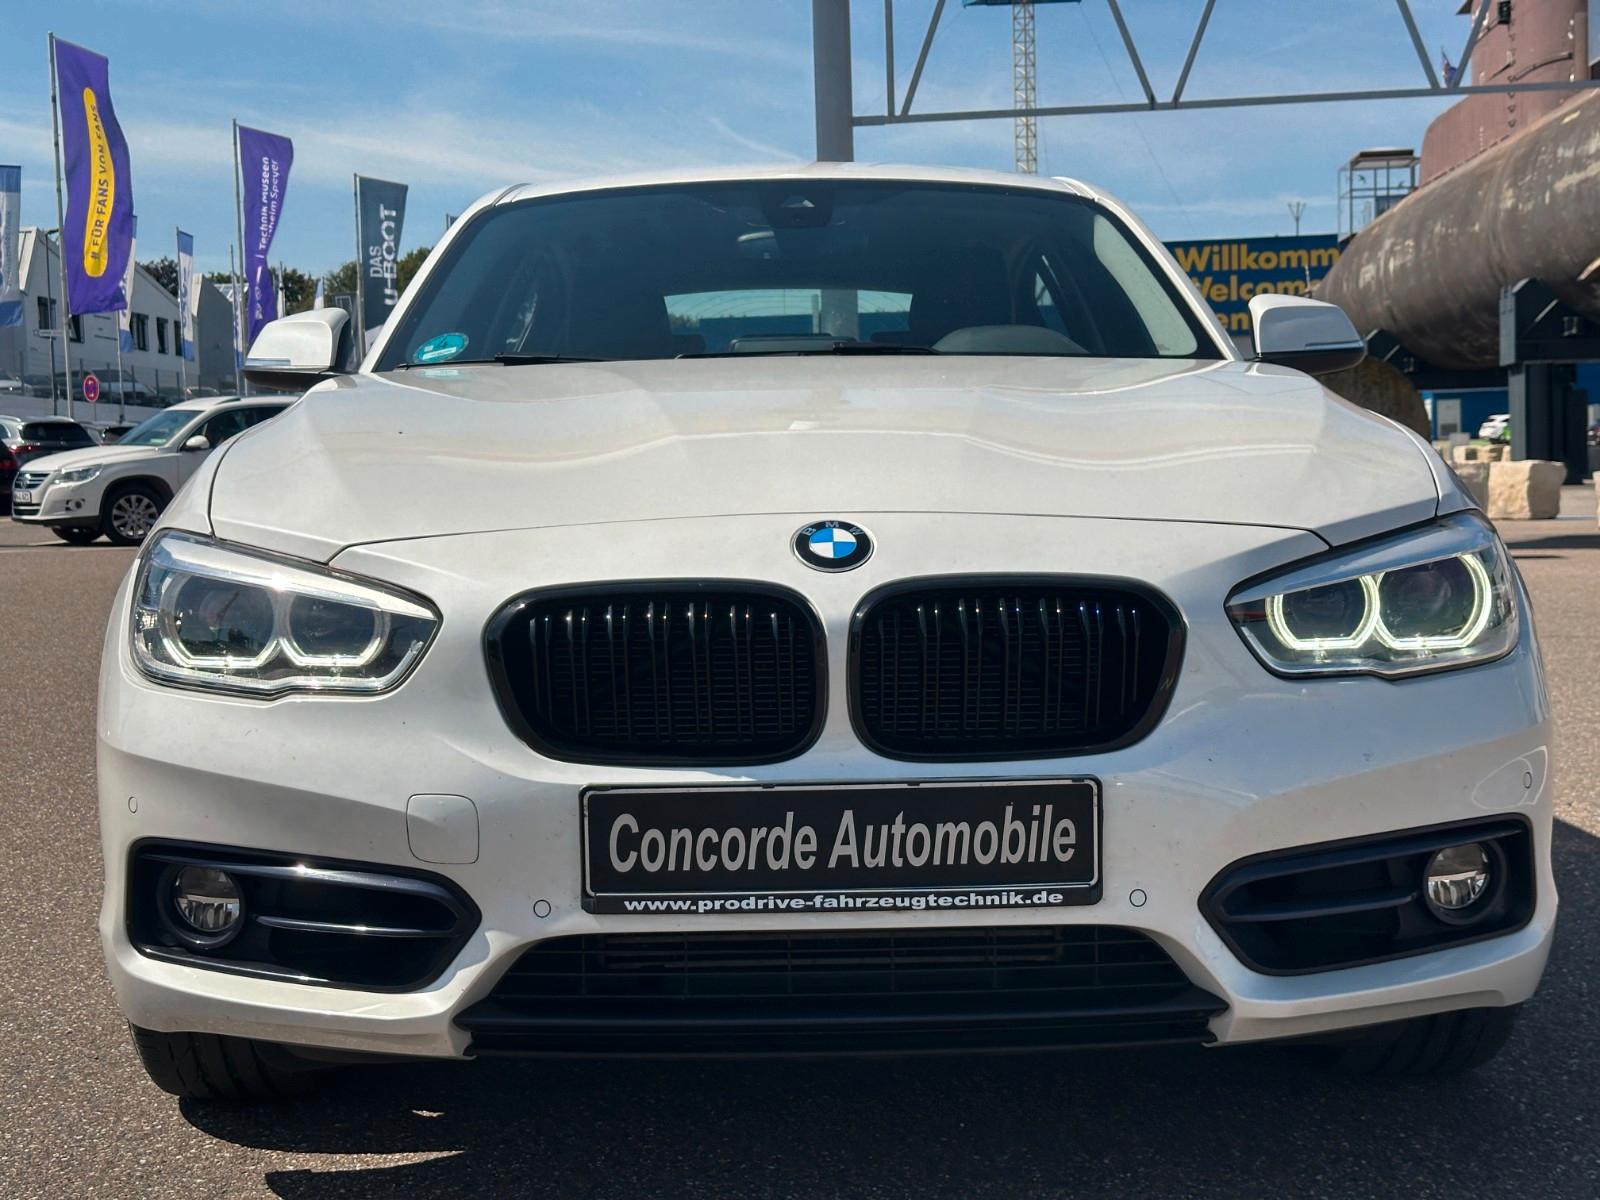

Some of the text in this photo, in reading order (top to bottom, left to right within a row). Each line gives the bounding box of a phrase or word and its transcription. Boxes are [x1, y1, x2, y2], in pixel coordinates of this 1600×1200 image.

[98, 144, 108, 174] VON
[270, 159, 280, 199] Speyer
[96, 178, 109, 215] FANS
[90, 219, 105, 247] FÜR
[259, 205, 268, 250] Technik
[369, 245, 383, 278] DAS
[801, 521, 865, 536] BMW
[609, 803, 1077, 873] Concorde Automobile
[623, 890, 1064, 913] www.prodrive-fahrzeugtechnik.de
